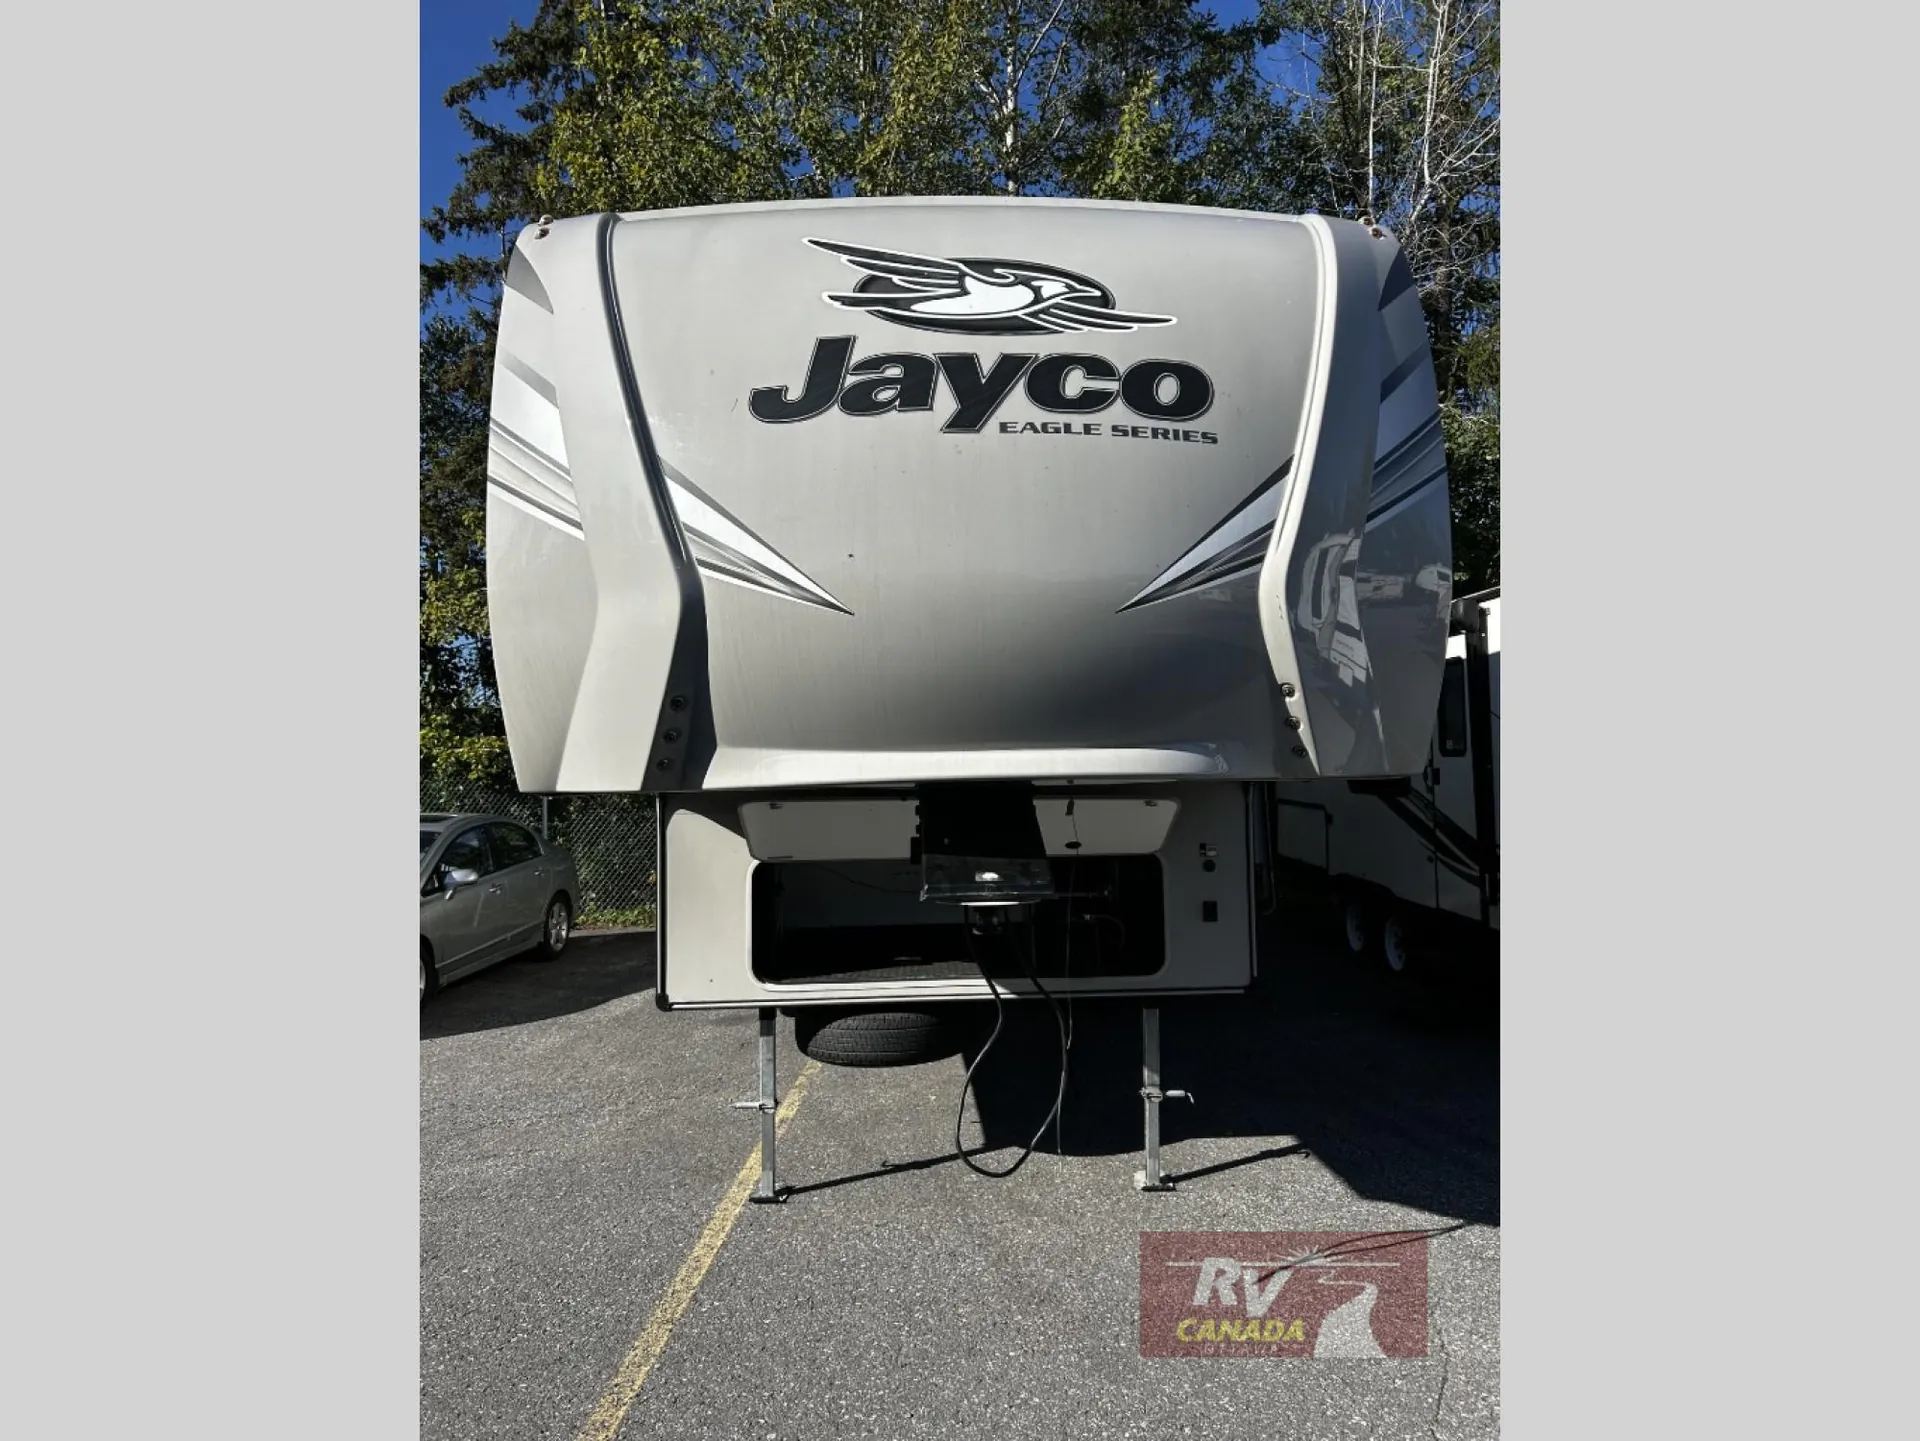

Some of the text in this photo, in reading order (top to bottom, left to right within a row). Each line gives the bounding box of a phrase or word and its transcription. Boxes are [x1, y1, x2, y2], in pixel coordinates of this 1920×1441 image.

[748, 335, 1215, 434] Jayco
[999, 421, 1218, 444] EAGLE SERIES
